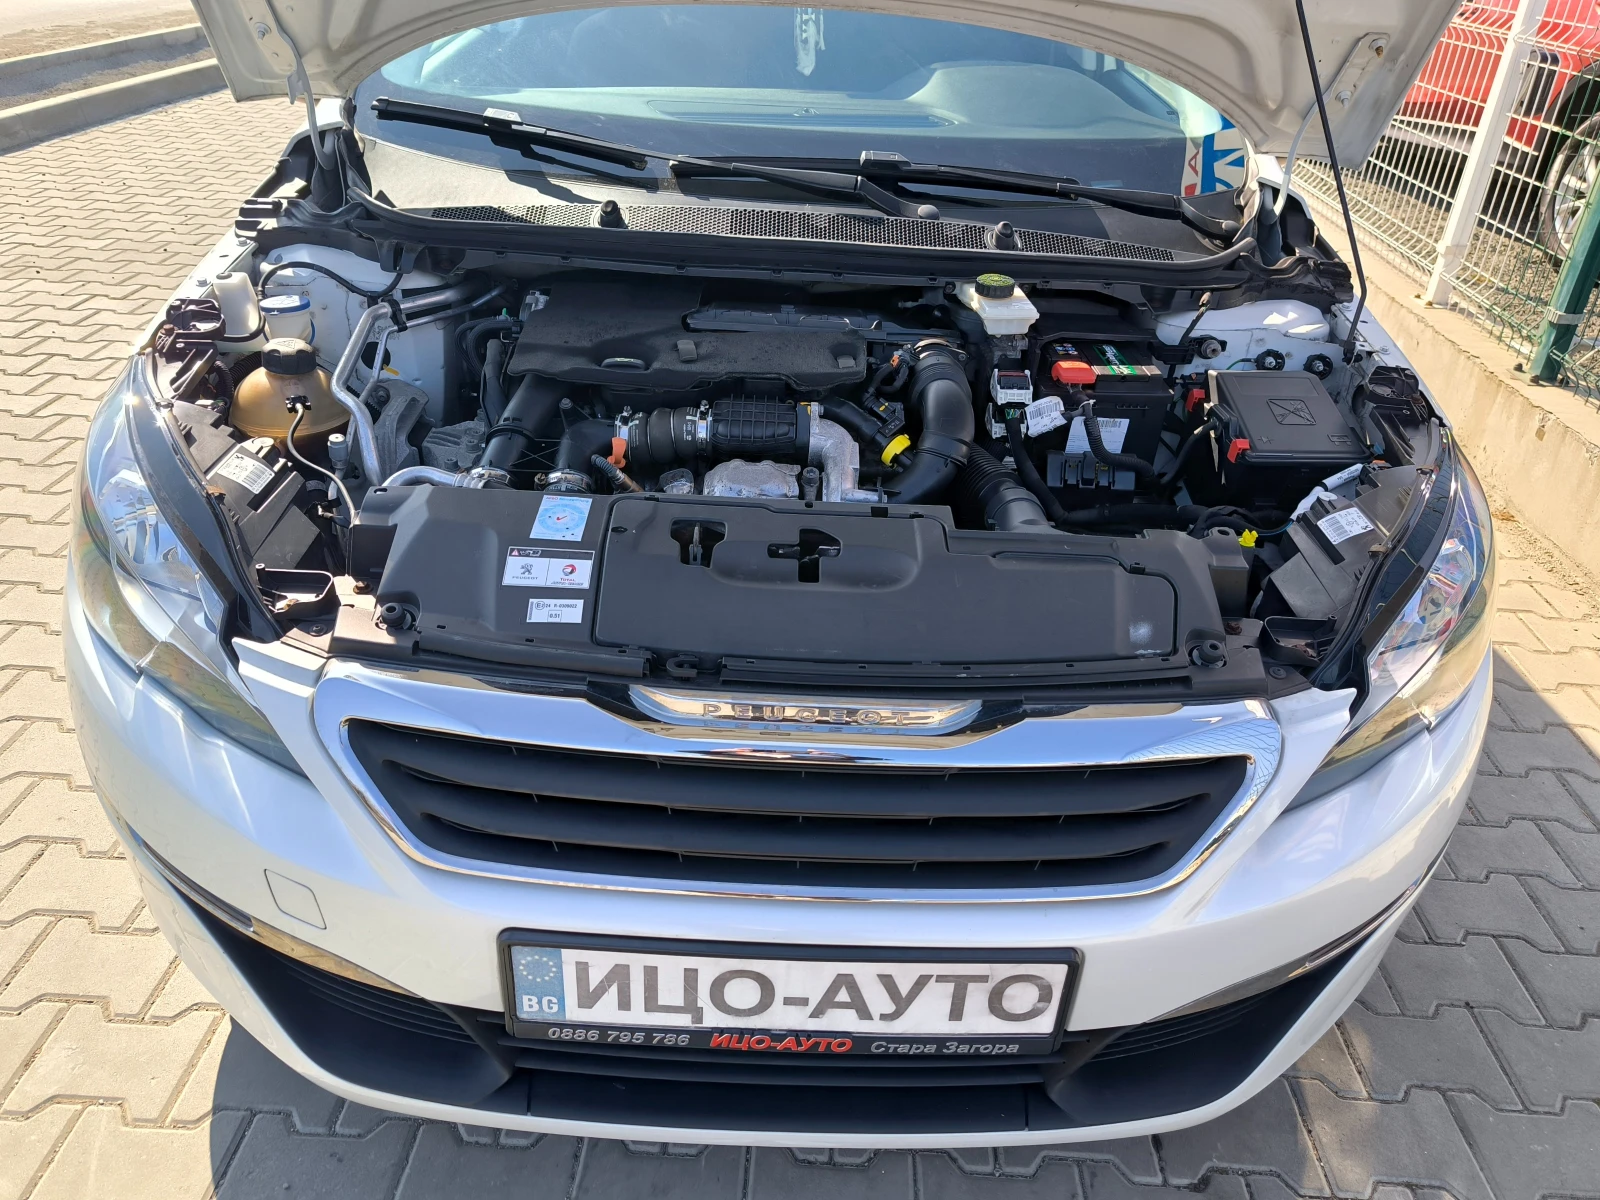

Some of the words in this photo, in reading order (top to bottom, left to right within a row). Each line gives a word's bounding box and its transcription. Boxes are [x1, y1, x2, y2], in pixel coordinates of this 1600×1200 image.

[702, 703, 912, 725] PEUGEOT
[575, 960, 1054, 1025] ИЦО-АУТО
[522, 995, 560, 1013] BG
[548, 1028, 601, 1042] 0886
[606, 1031, 646, 1044] 795
[652, 1032, 691, 1046] 786
[710, 1033, 852, 1052] ИЦО-АУТО
[870, 1041, 937, 1055] Стара
[942, 1042, 1020, 1056] Загора
